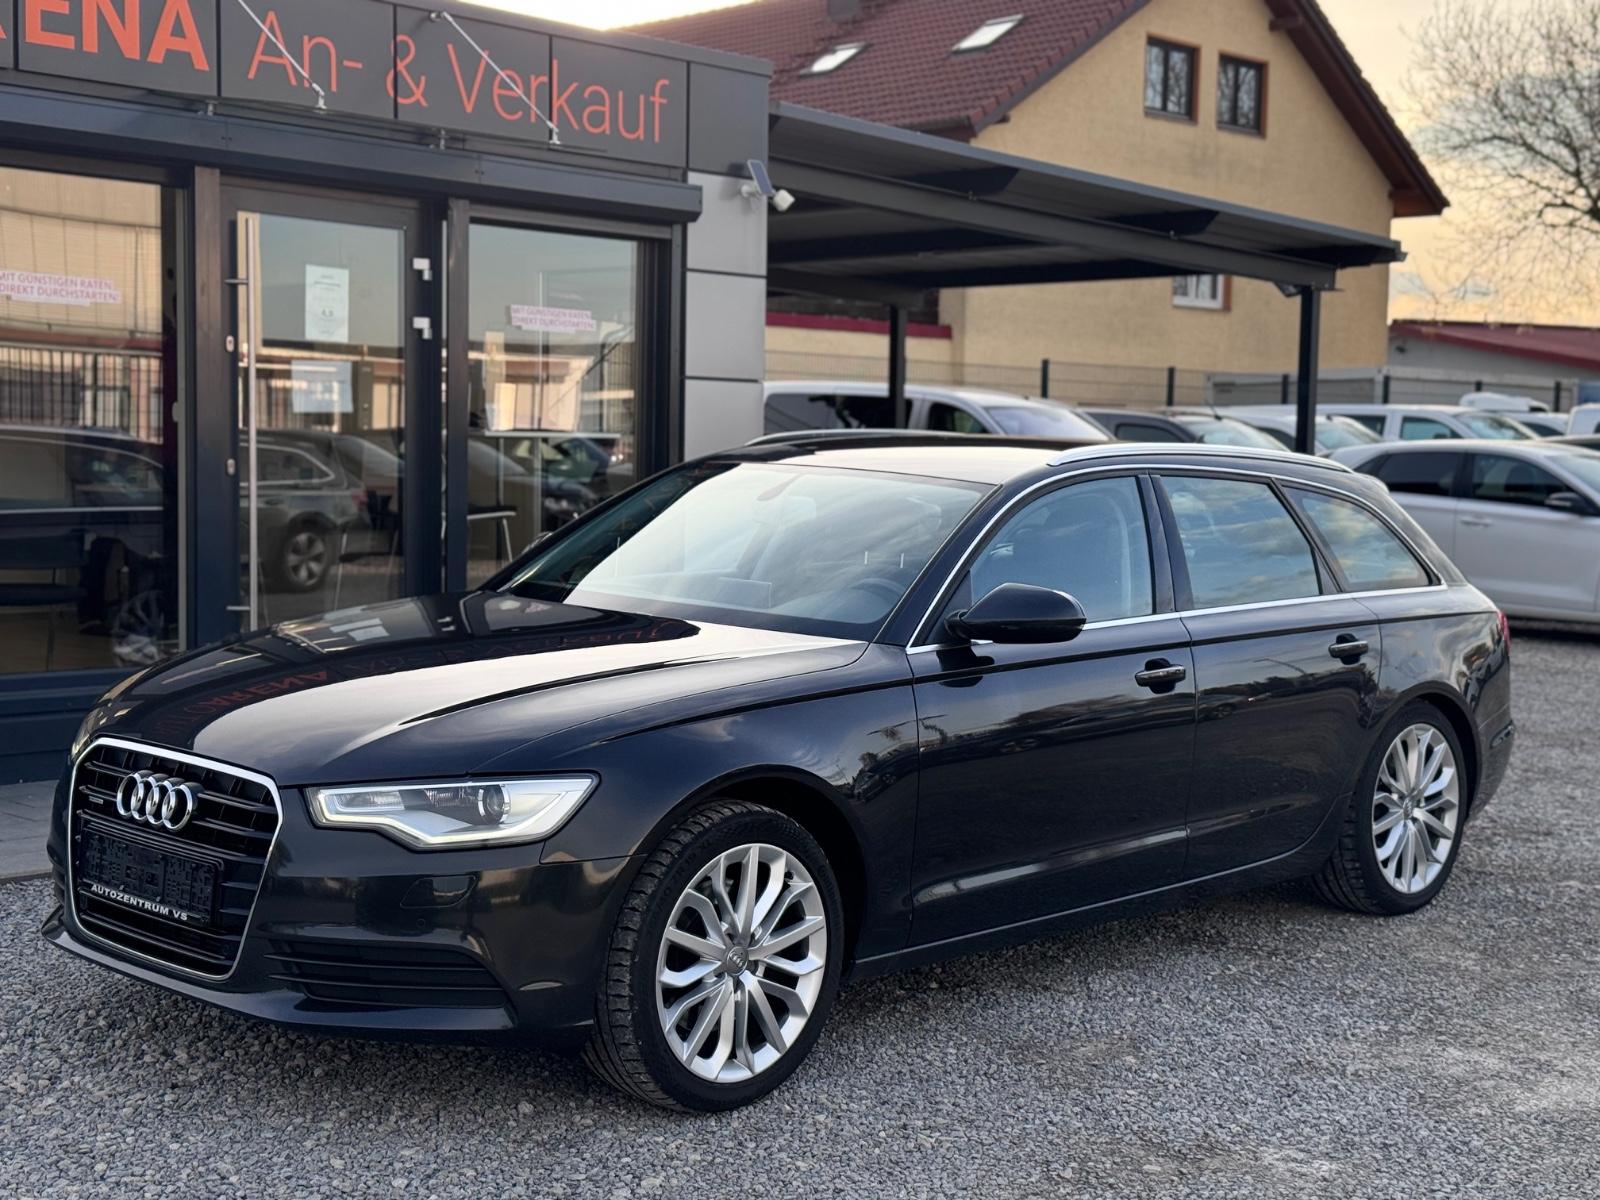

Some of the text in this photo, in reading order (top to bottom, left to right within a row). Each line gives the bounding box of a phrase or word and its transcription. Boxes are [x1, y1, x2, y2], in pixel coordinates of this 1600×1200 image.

[0, 0, 669, 143] ENA An- & Verkauf
[0, 283, 34, 296] DIREKT
[91, 883, 188, 921] AUTOZENTRUM VS
